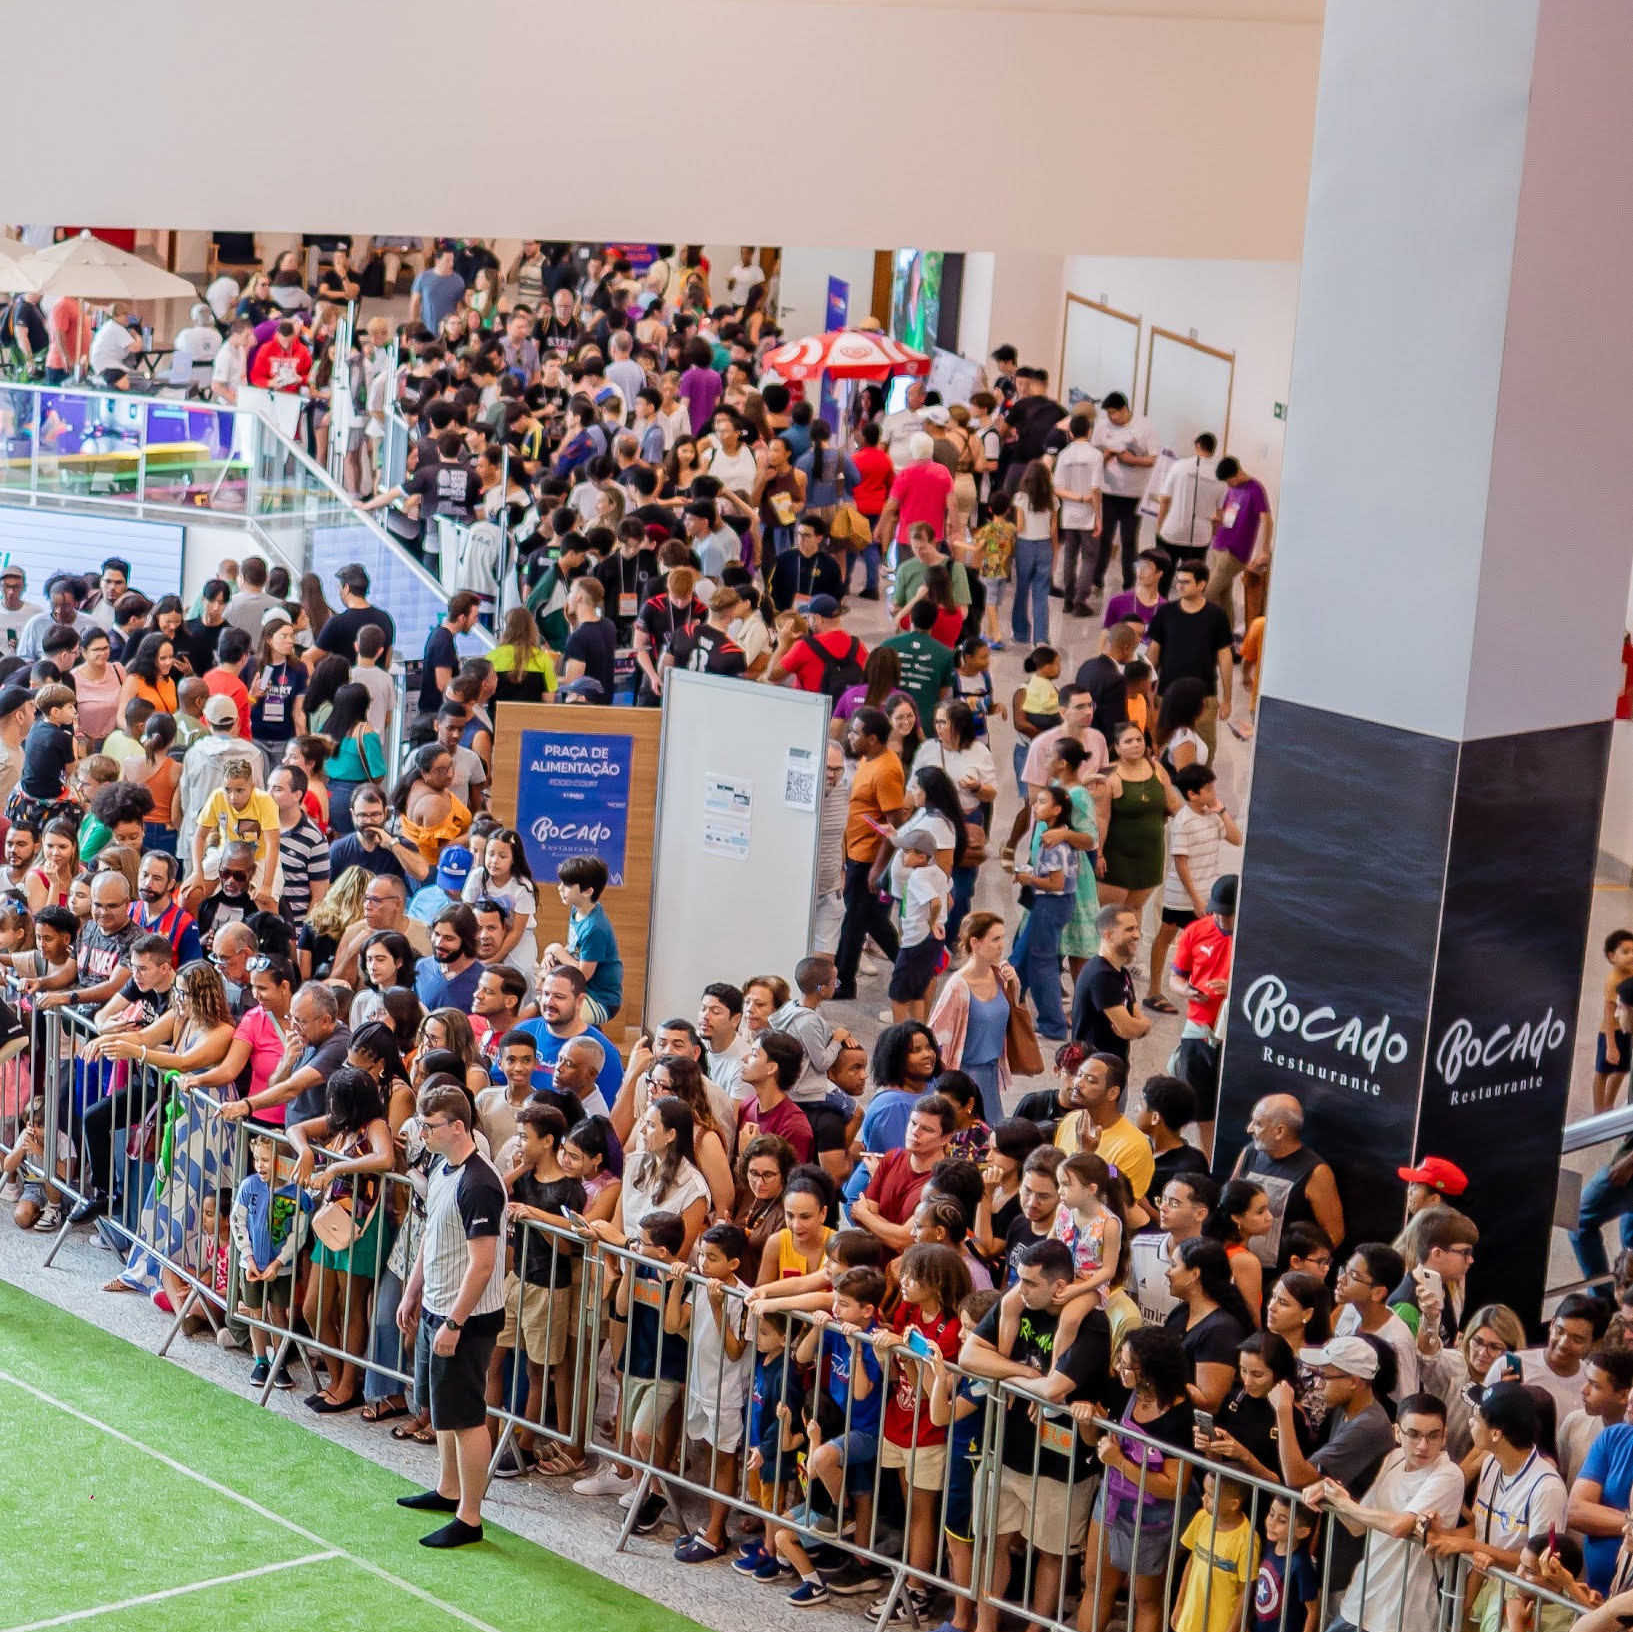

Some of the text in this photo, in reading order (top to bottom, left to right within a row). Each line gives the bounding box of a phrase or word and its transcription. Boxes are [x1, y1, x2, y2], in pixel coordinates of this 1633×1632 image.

[544, 744, 609, 760] PRAÇA DE
[530, 760, 621, 778] ALIMENTAÇÃO
[1261, 1045, 1382, 1097] Restaurante
[1450, 1074, 1544, 1107] Restaurante
